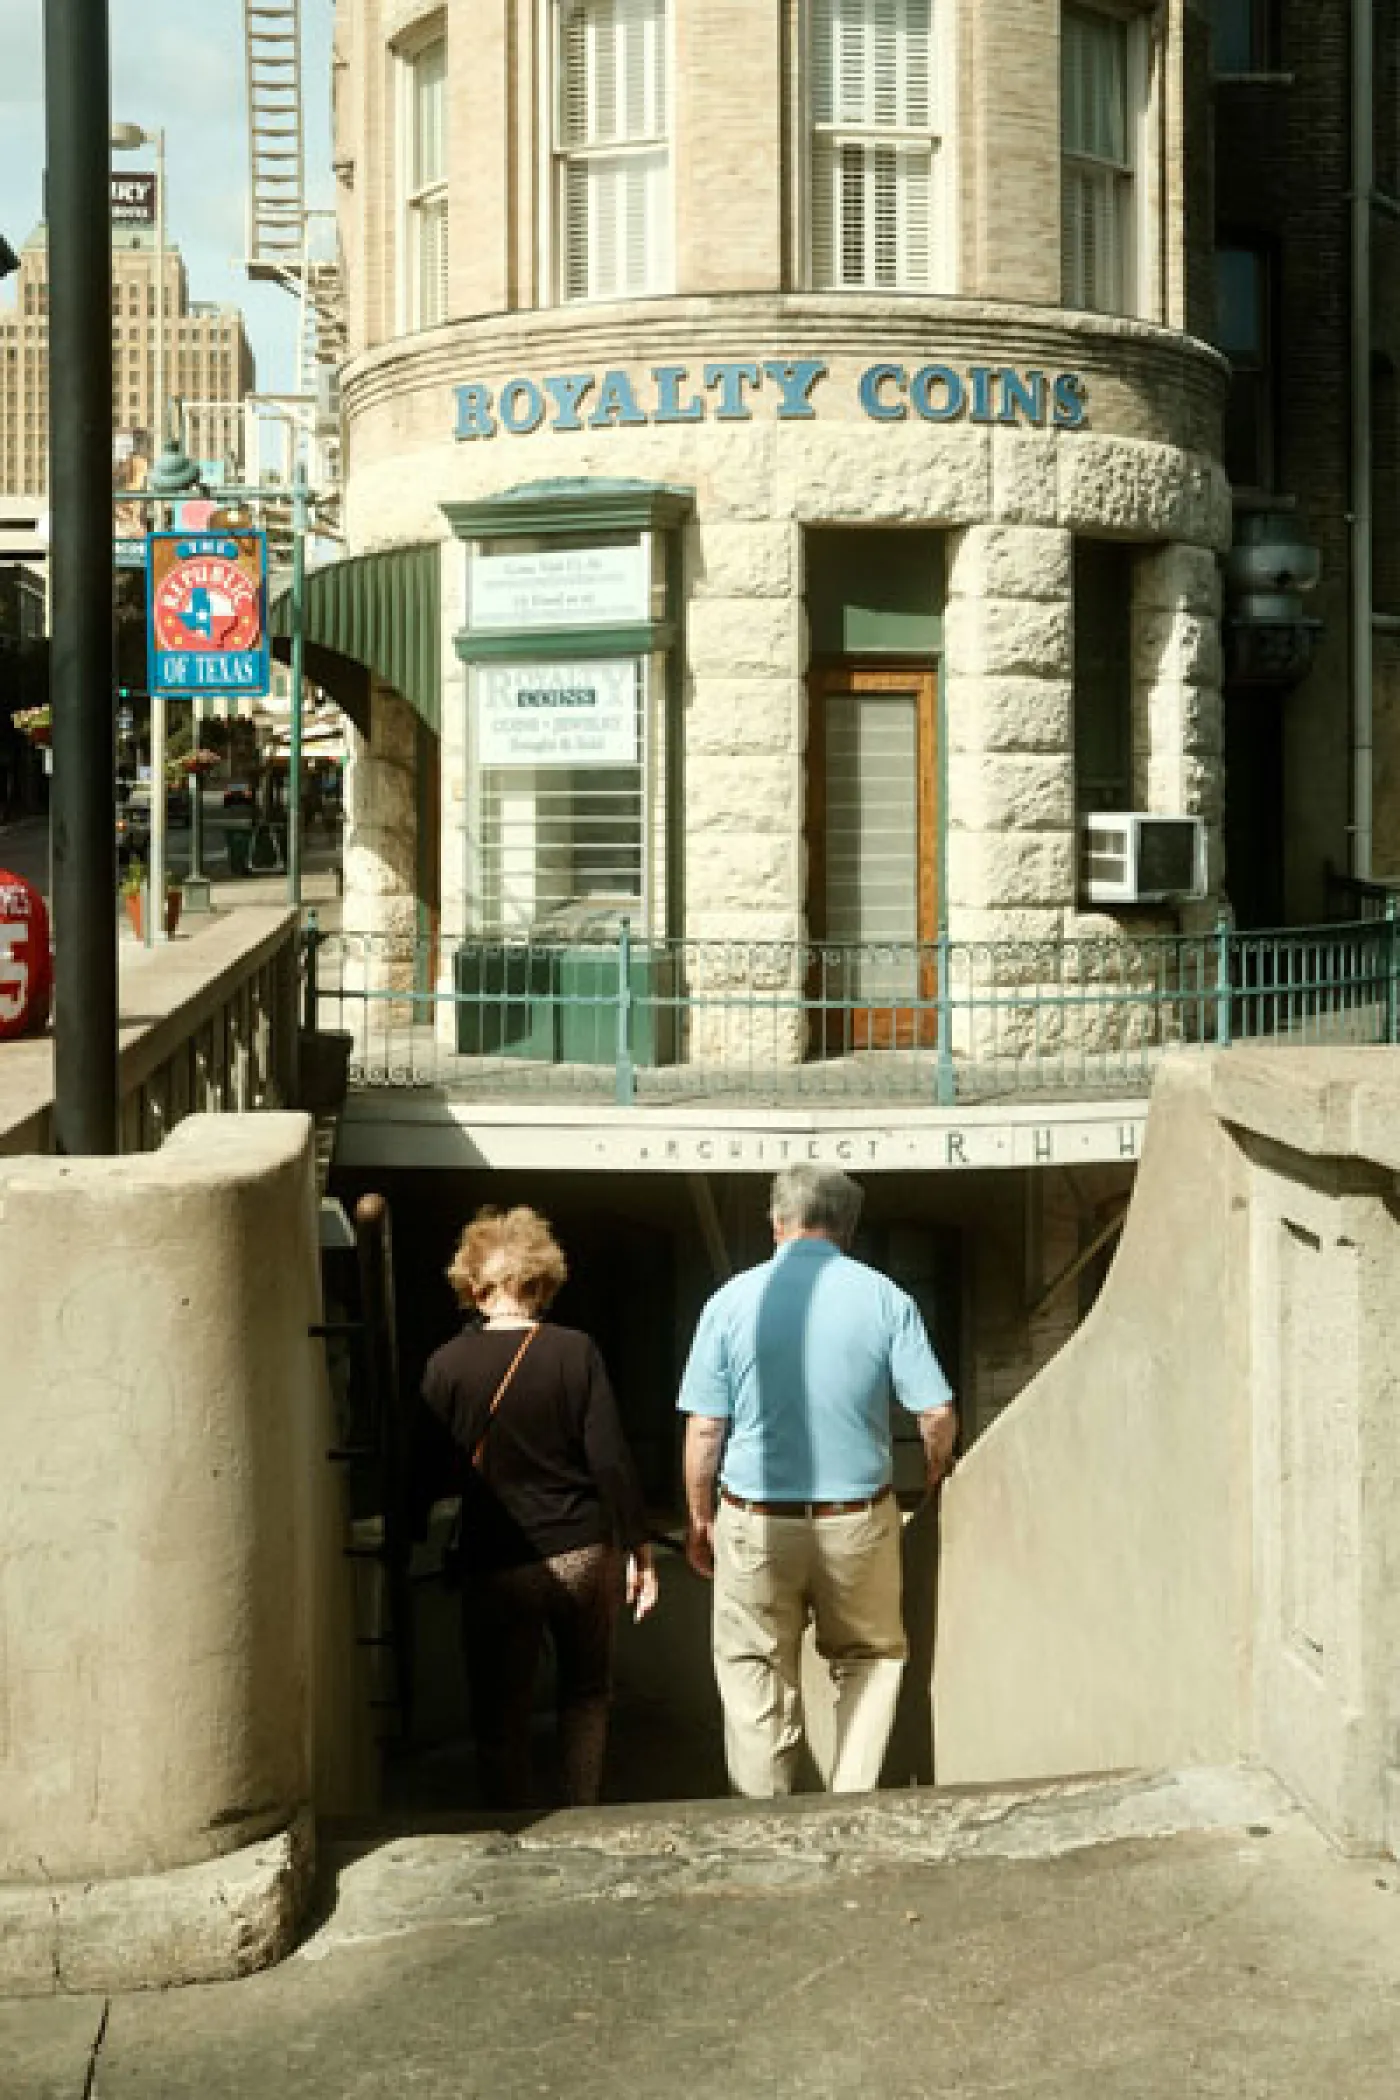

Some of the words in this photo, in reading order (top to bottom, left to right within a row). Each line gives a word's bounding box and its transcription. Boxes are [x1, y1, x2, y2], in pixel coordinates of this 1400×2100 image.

[453, 360, 826, 442] ROYALTY
[858, 363, 1092, 430] COINS
[188, 540, 226, 554] THE
[162, 563, 254, 609] REPUBLIC
[163, 656, 188, 684] OF
[194, 656, 254, 684] TEXAS
[485, 667, 628, 708] ROYALTY
